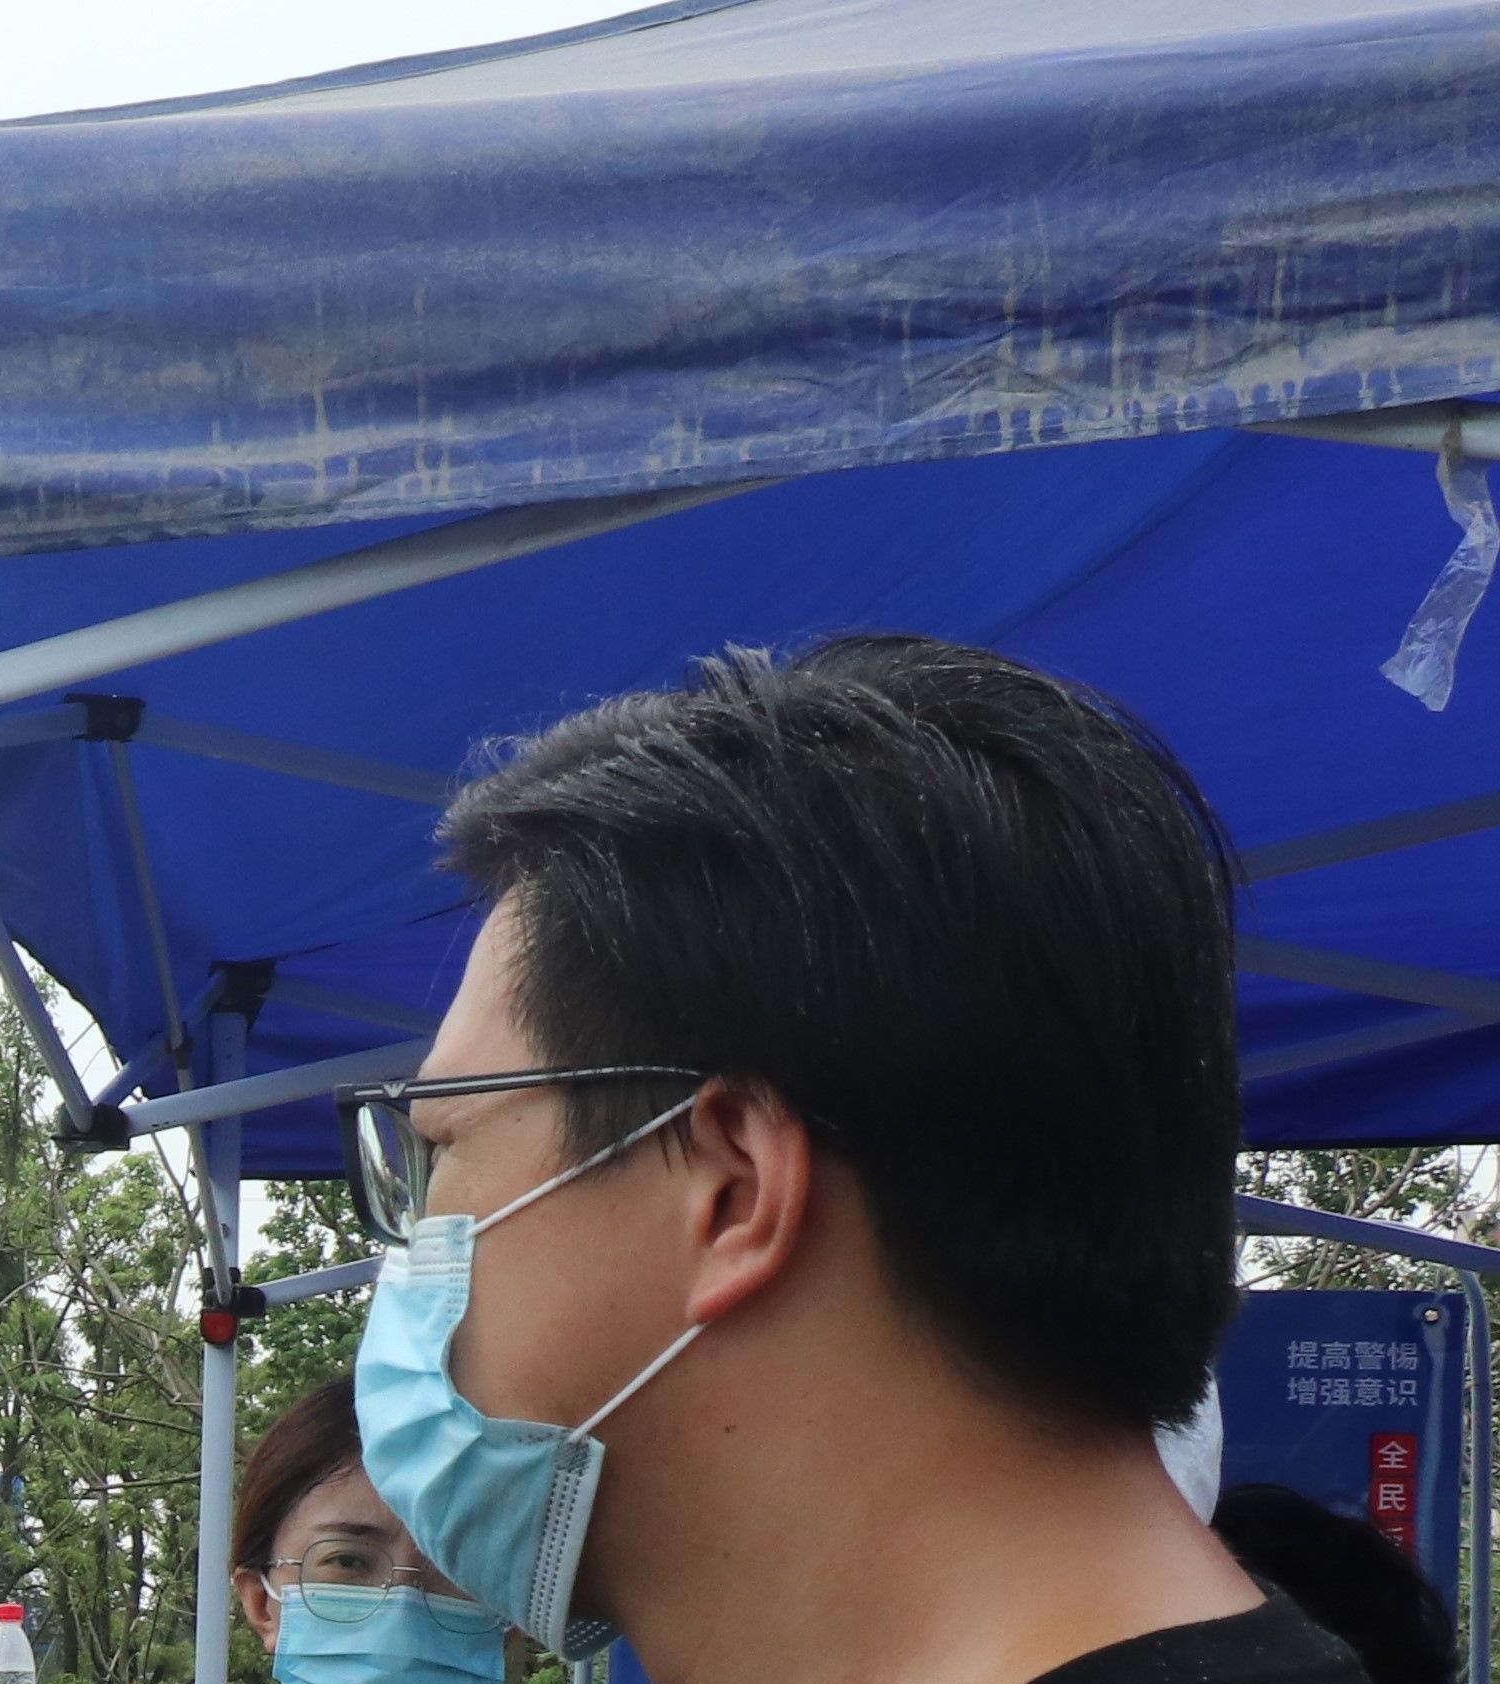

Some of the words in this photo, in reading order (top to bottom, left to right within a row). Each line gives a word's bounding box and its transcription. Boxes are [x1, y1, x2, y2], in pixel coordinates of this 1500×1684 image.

[1287, 1340, 1419, 1371] 提高警惕
[1287, 1377, 1418, 1406] 增强意识
